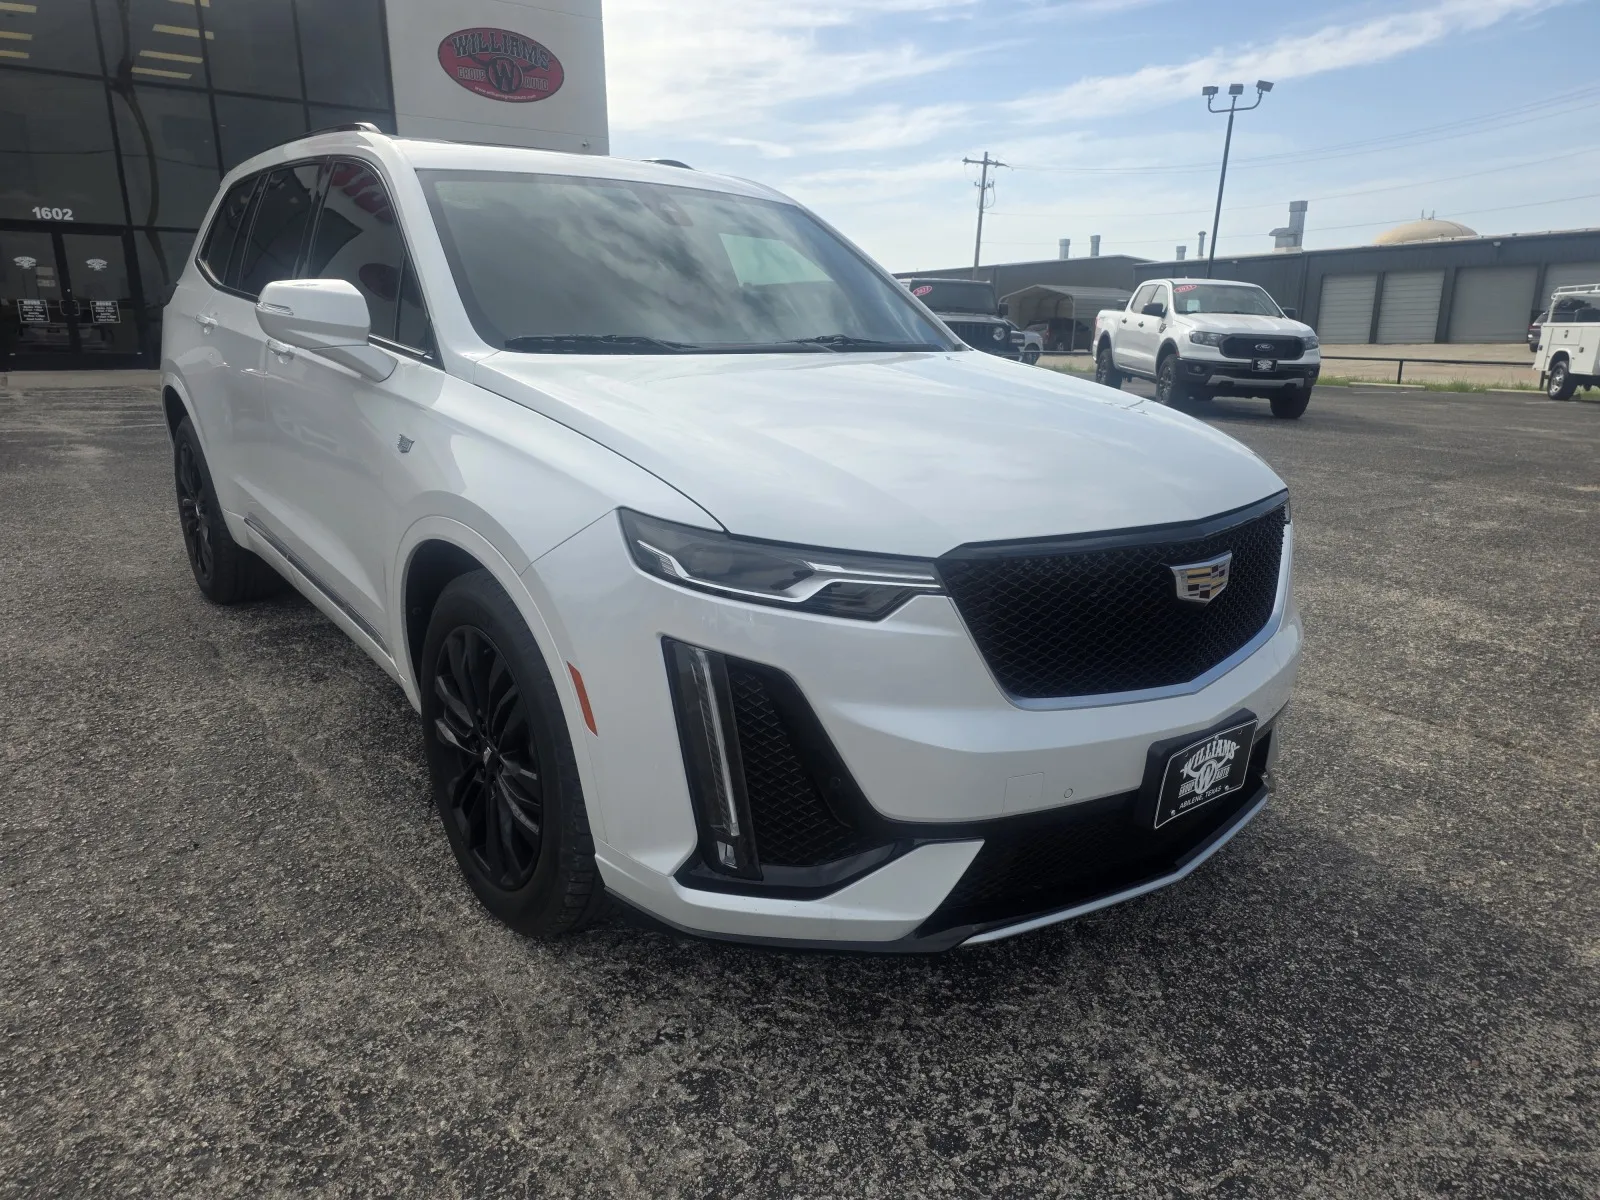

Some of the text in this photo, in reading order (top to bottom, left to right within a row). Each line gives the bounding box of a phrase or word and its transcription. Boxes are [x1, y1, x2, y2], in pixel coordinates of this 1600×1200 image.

[452, 31, 550, 72] WILLIAMS
[457, 58, 549, 93] GROUP W AUTO
[32, 206, 74, 221] 1602
[1183, 739, 1237, 780] WILLIAMS
[1205, 785, 1222, 798] TEXAS
